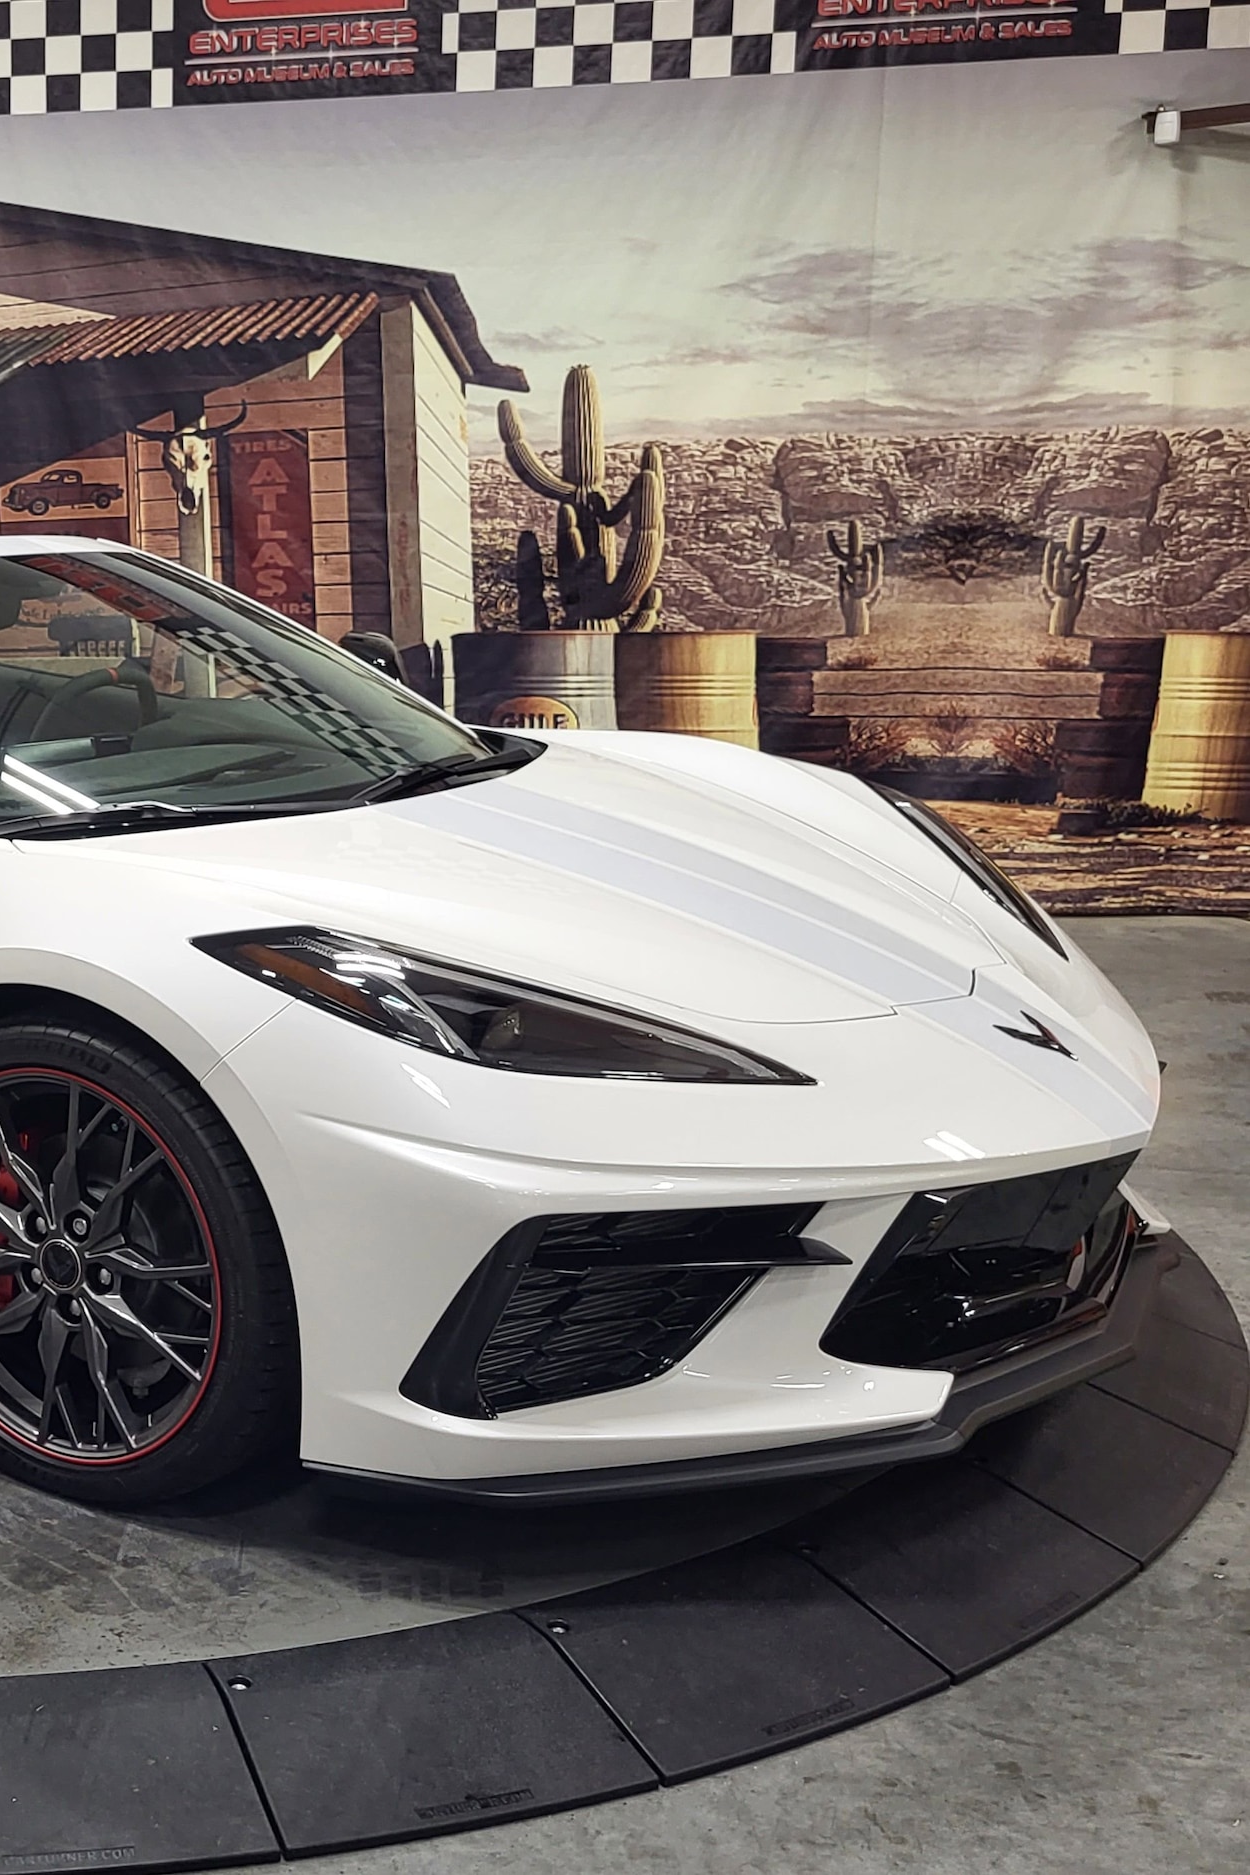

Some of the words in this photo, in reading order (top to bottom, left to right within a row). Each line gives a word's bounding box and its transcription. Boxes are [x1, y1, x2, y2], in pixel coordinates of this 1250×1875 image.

[189, 17, 419, 56] ENTERPRISES
[813, 30, 876, 49] AUTO
[877, 25, 976, 46] MUSEUM
[999, 20, 1073, 39] SALES
[186, 68, 242, 87] AUTO
[243, 64, 331, 84] MUSEUM
[349, 59, 416, 78] SALES
[231, 439, 293, 454] TIRES
[248, 457, 295, 598] ATLAS
